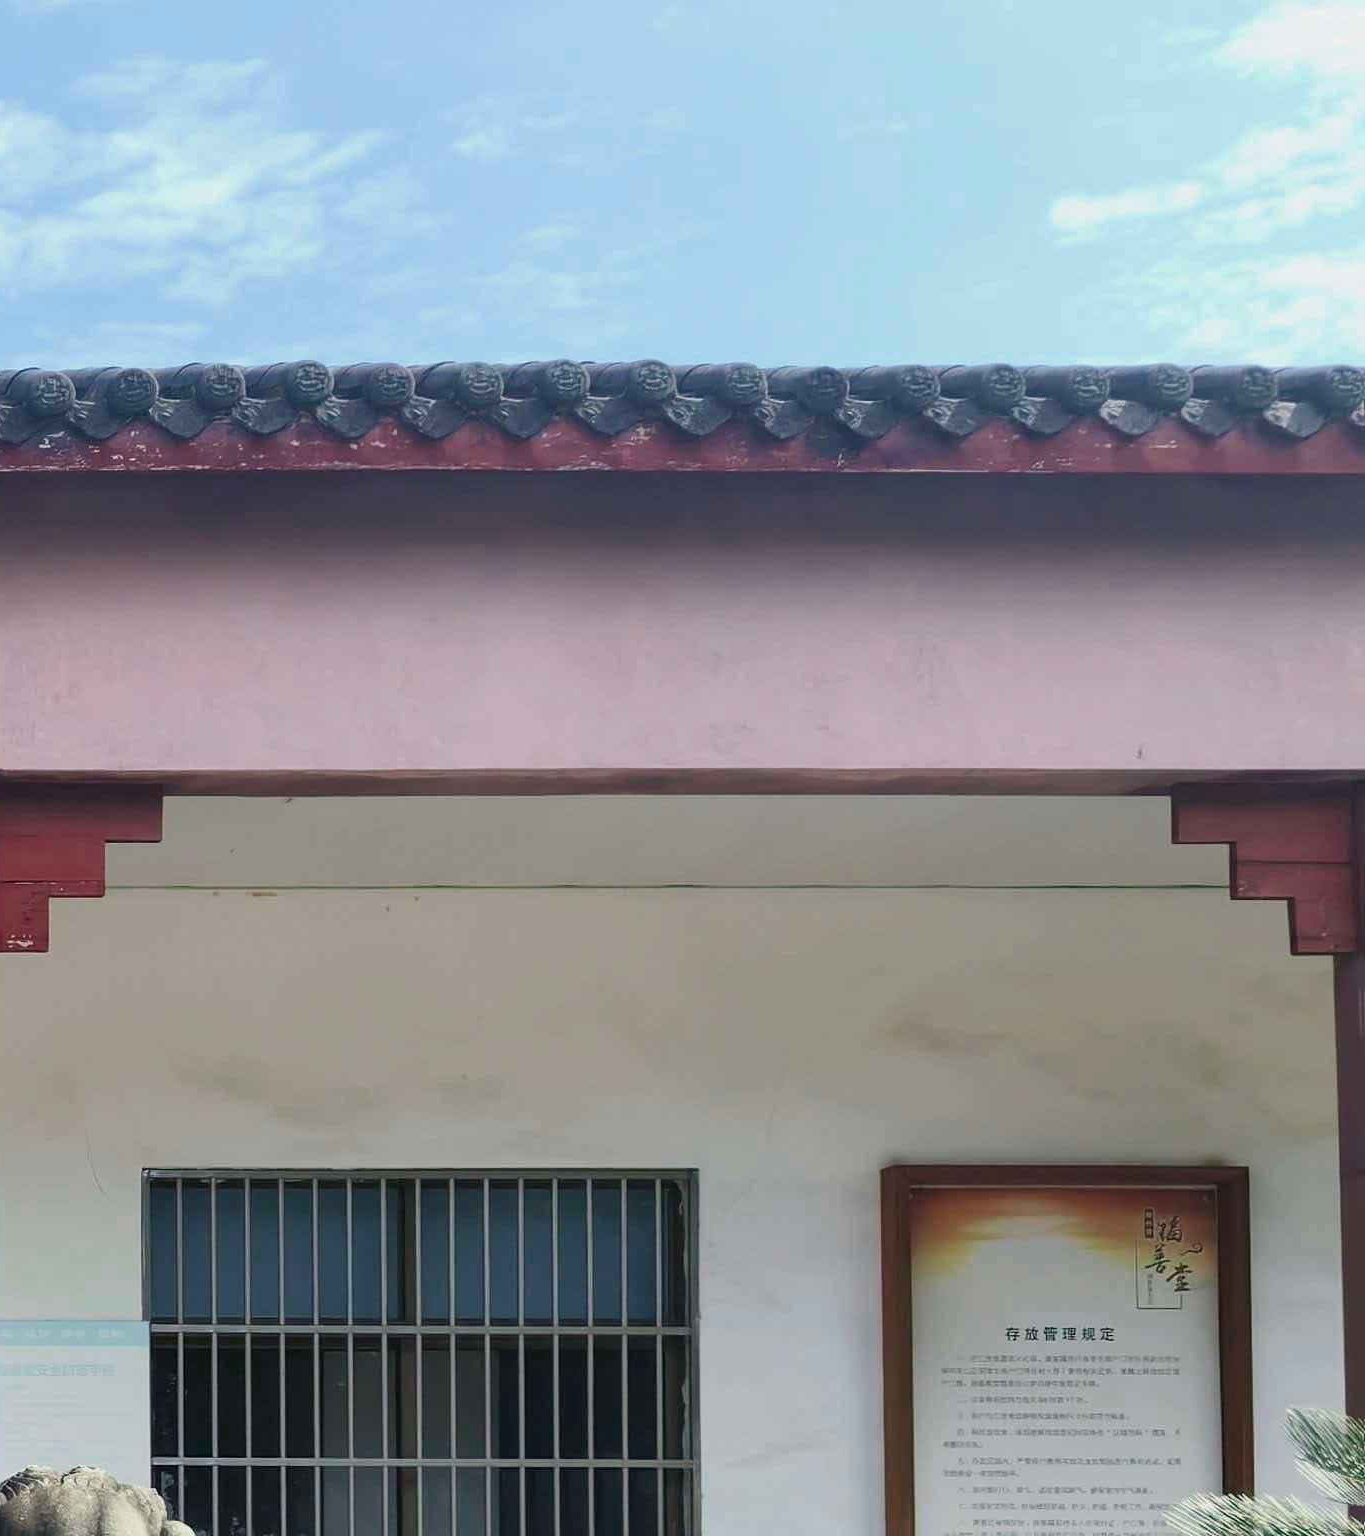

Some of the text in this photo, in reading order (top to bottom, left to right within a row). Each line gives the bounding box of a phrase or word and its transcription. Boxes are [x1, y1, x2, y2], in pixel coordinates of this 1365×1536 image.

[1005, 1326, 1117, 1343] 存放管理规定
